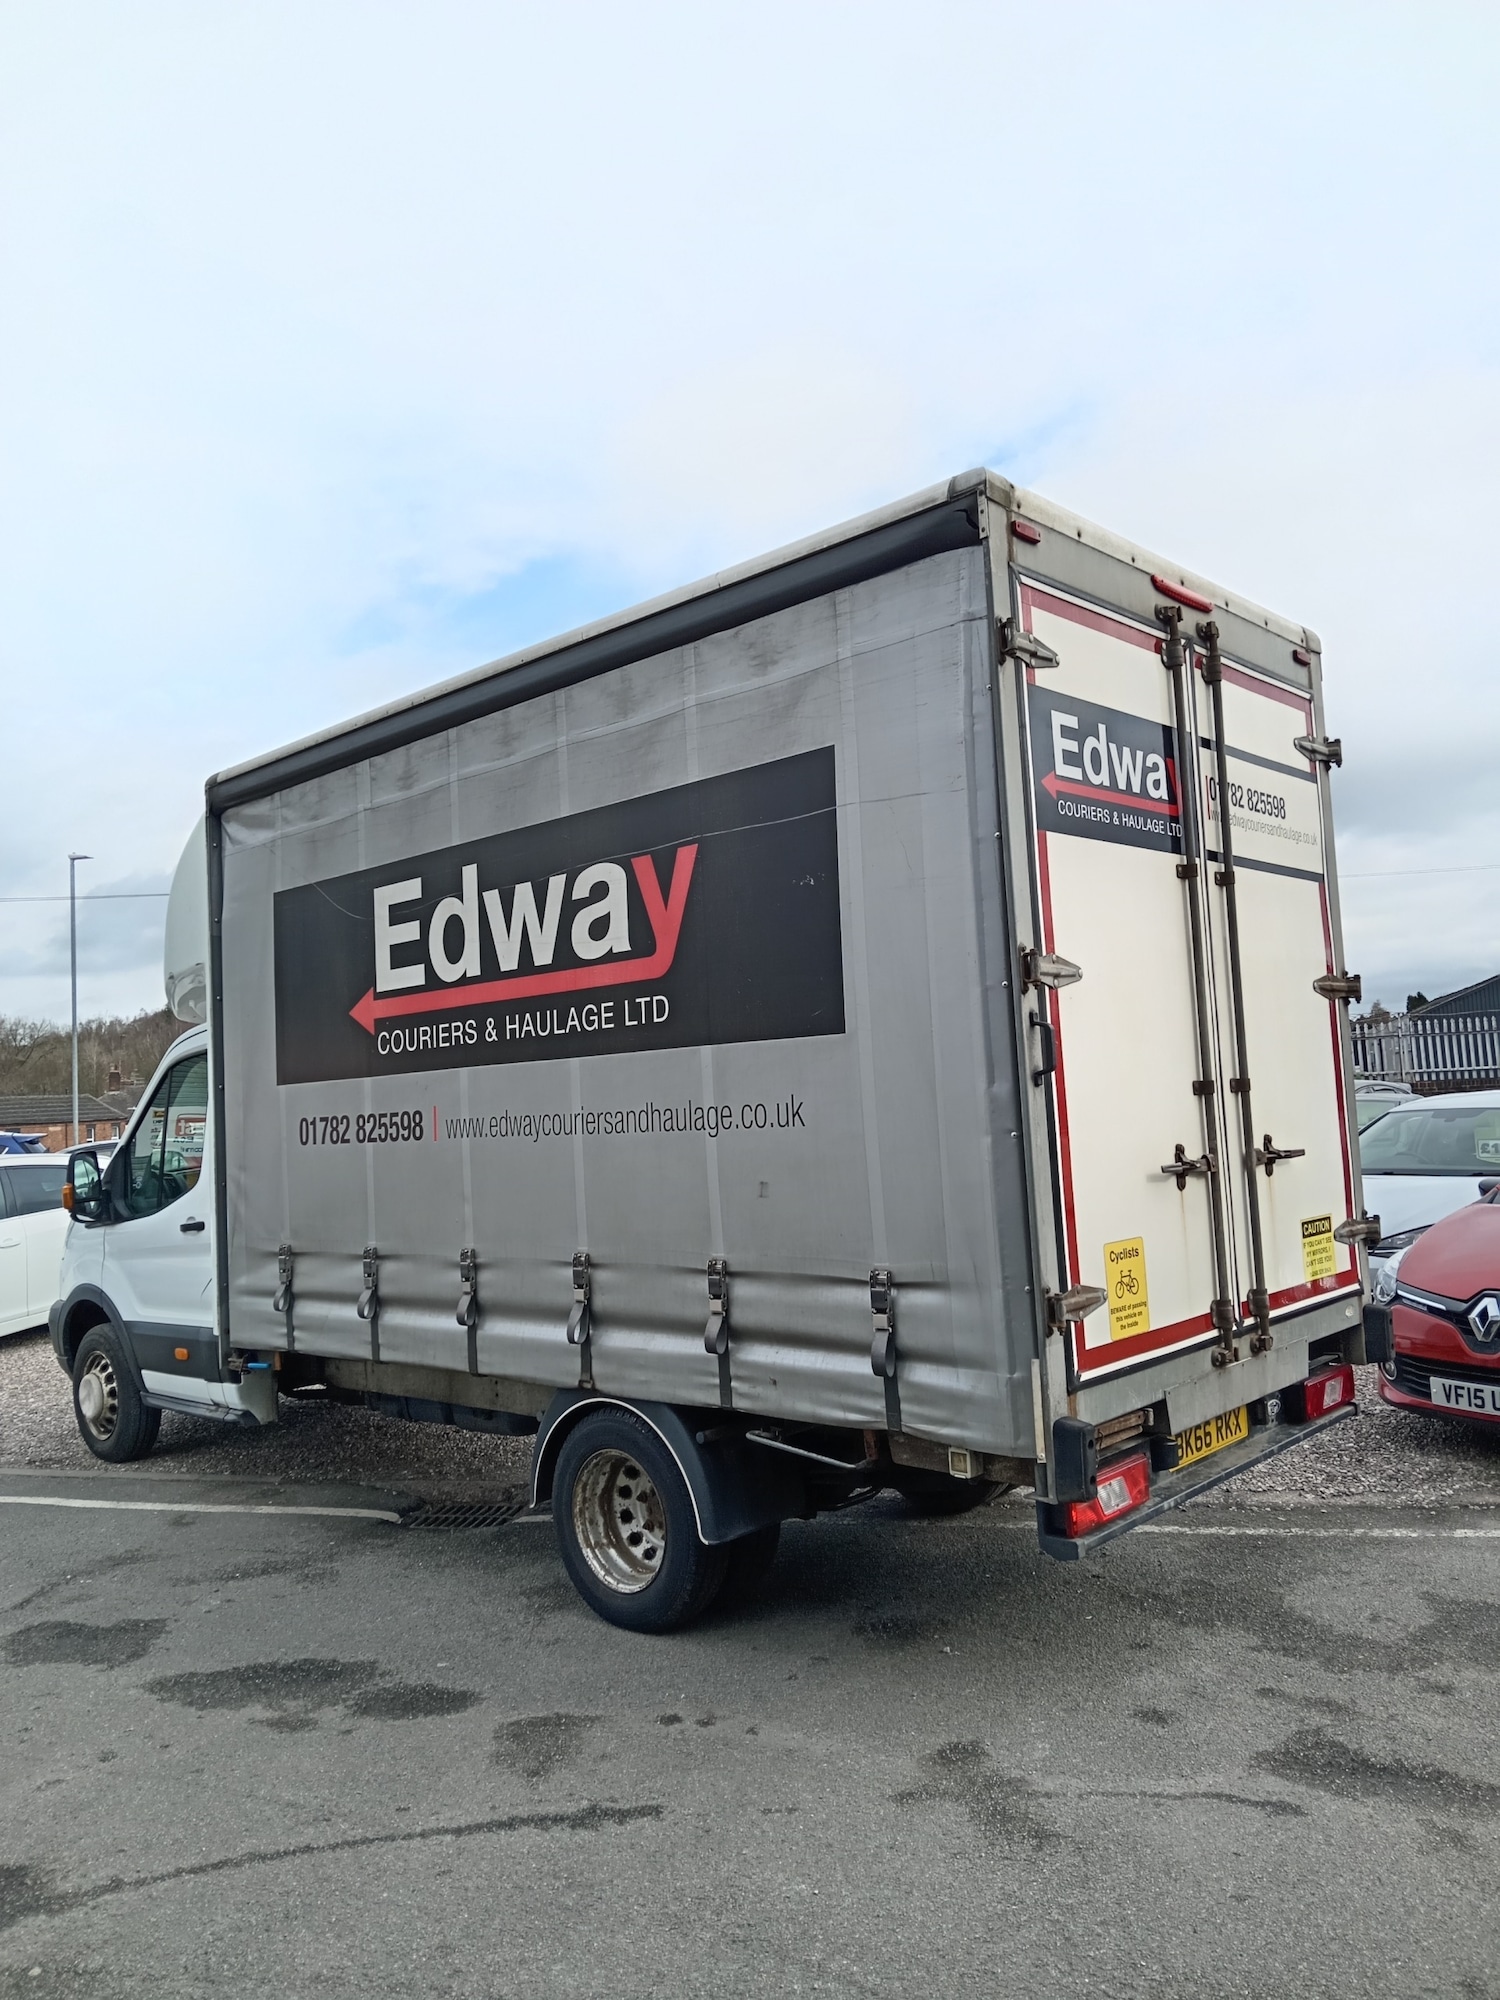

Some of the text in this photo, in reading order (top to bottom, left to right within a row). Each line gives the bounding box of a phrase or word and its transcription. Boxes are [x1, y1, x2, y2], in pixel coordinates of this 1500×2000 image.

[1058, 799, 1110, 824] COURIERS
[1113, 811, 1119, 825] &
[1122, 812, 1165, 835] HAULAGE
[1247, 787, 1286, 820] 825598
[373, 843, 699, 993] Edway
[376, 994, 670, 1055] COURIERS & HAULAGE LTD
[299, 1093, 806, 1146] 01782 825598 www.edwaycouriersandhaulage.co.uk
[1303, 1219, 1330, 1236] CAUTION
[1109, 1246, 1140, 1265] Cyclists
[1110, 1304, 1127, 1315] BEWARE
[1132, 1300, 1147, 1311] passing
[1124, 1311, 1137, 1320] vehicle
[1442, 1382, 1486, 1410] VF15
[1215, 1405, 1243, 1445] RKX
